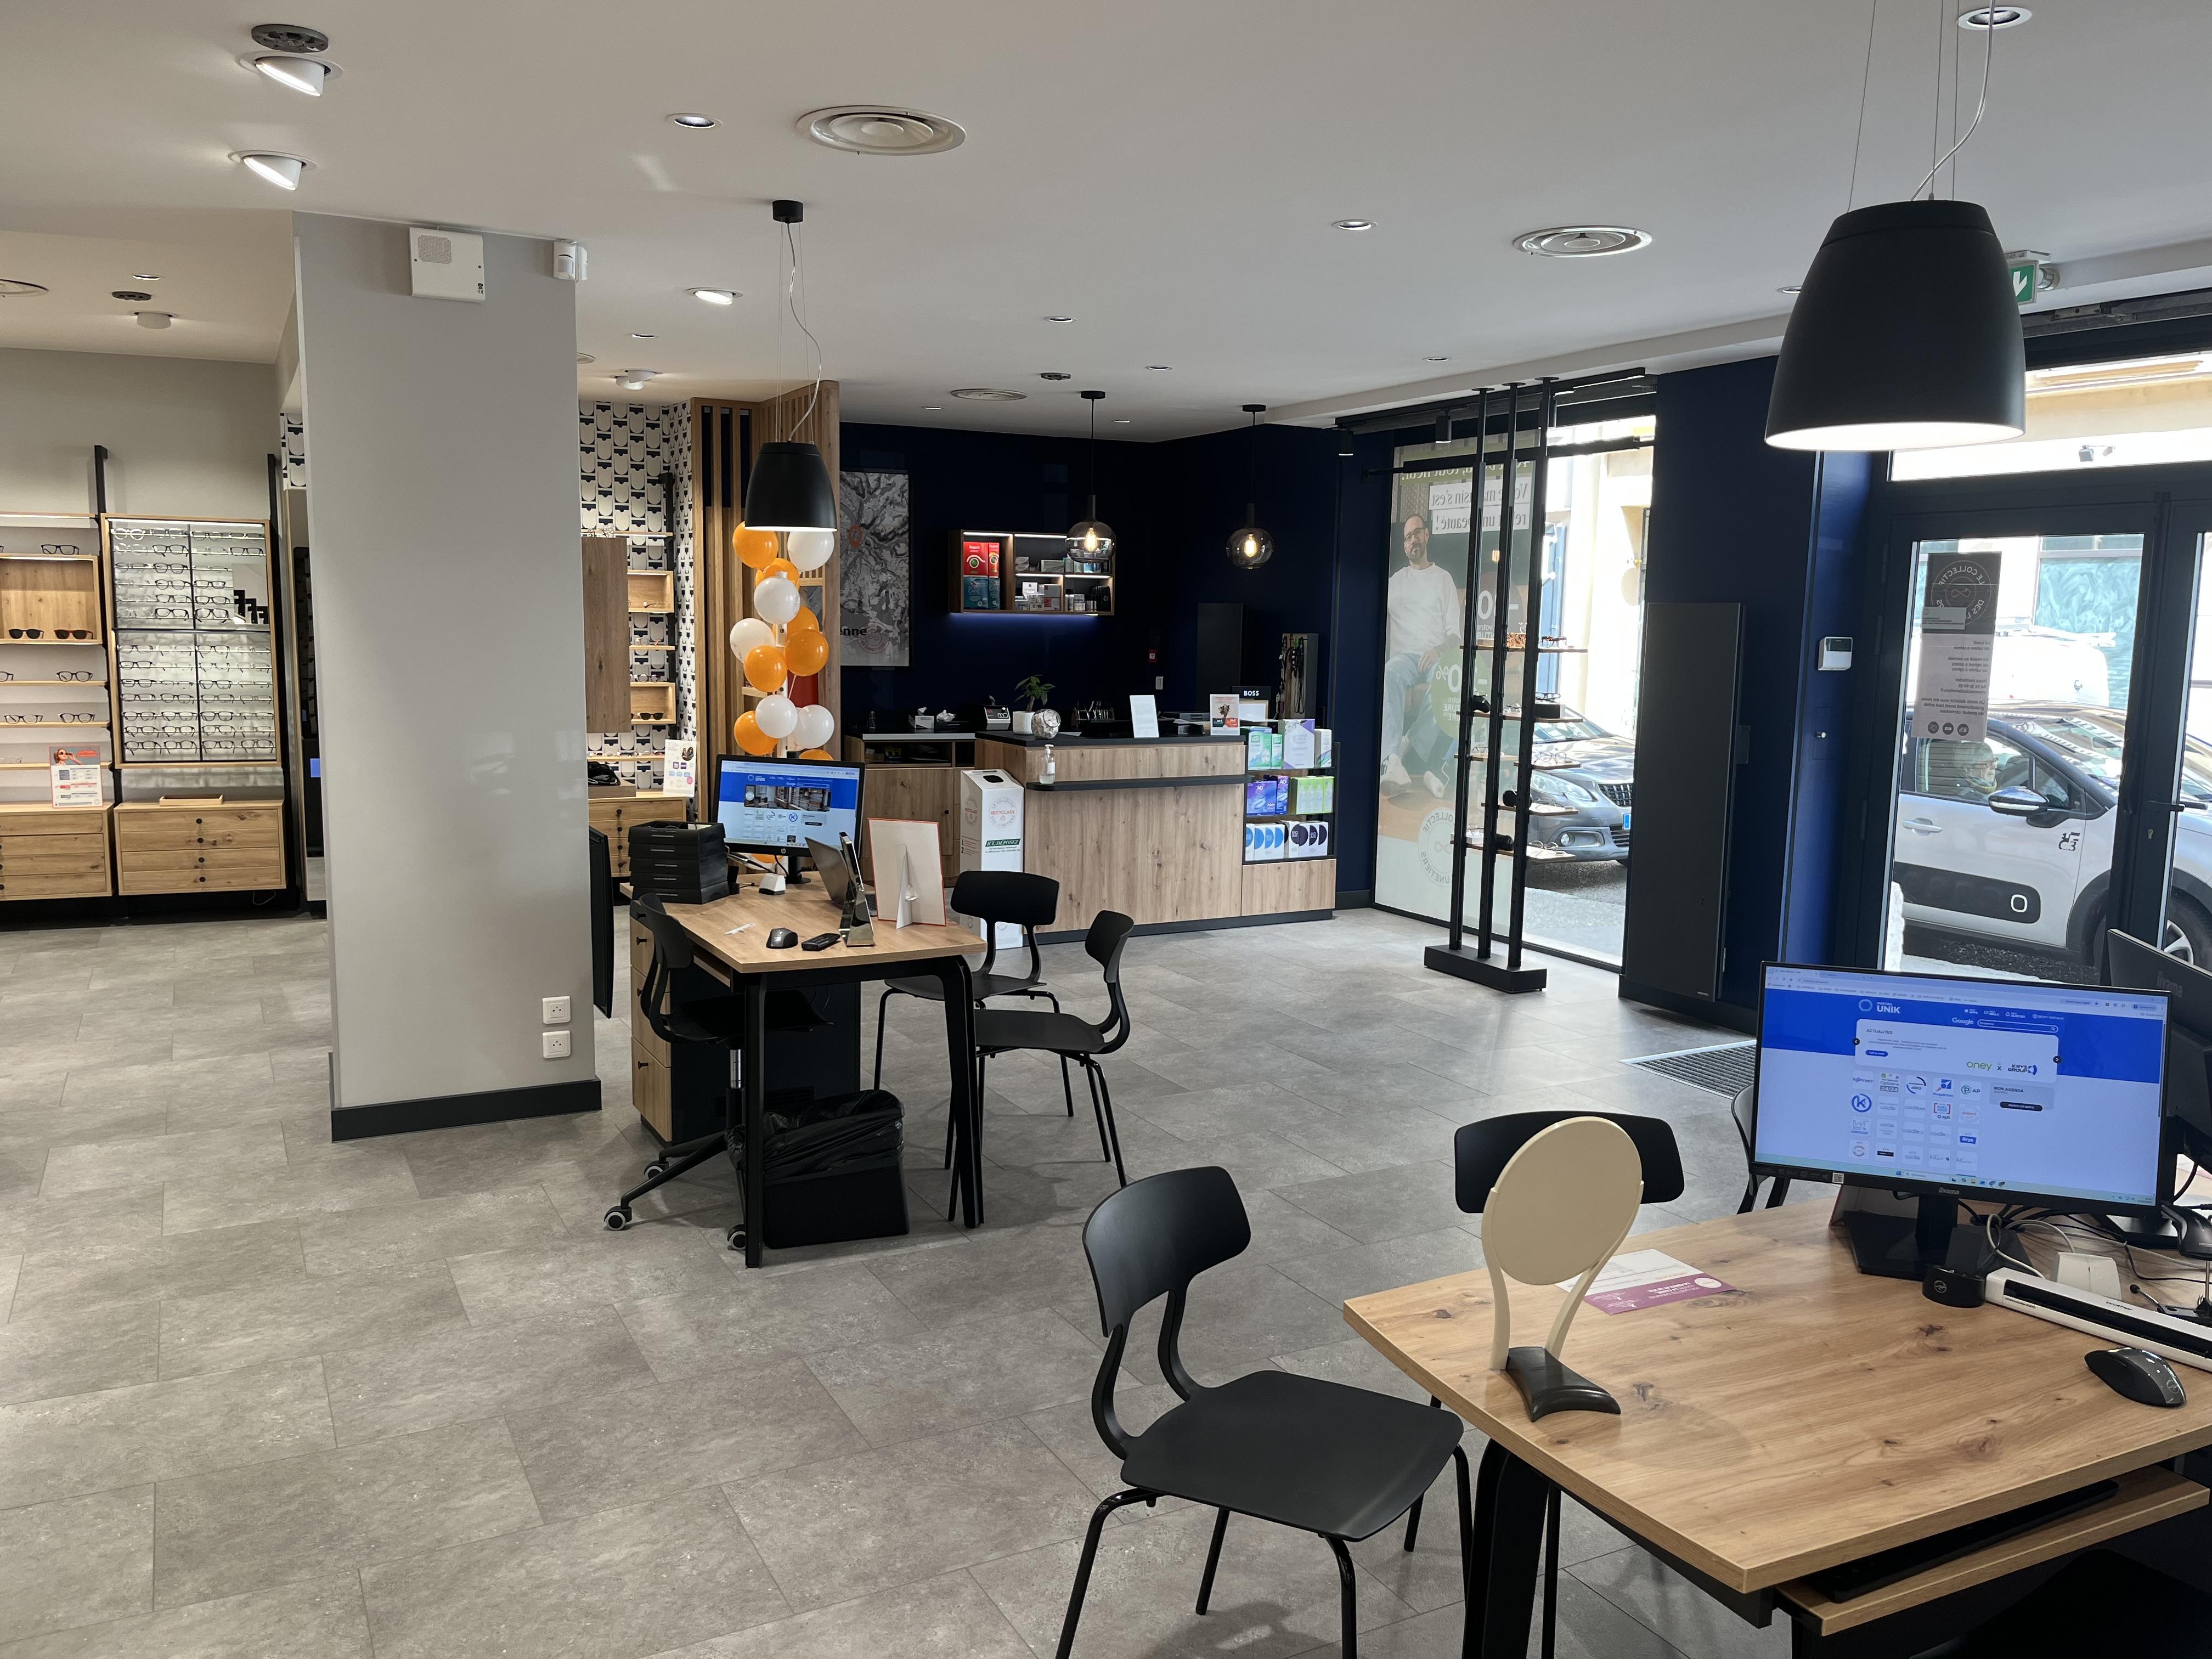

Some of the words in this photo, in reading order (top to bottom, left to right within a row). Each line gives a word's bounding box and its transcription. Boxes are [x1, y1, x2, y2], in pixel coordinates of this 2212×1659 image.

[2058, 841, 2076, 851] C3
[1876, 1005, 1901, 1014] UNIK
[1951, 1017, 1974, 1025] Google
[1966, 1062, 1992, 1071] oney
[2106, 1301, 2133, 1311] brother
